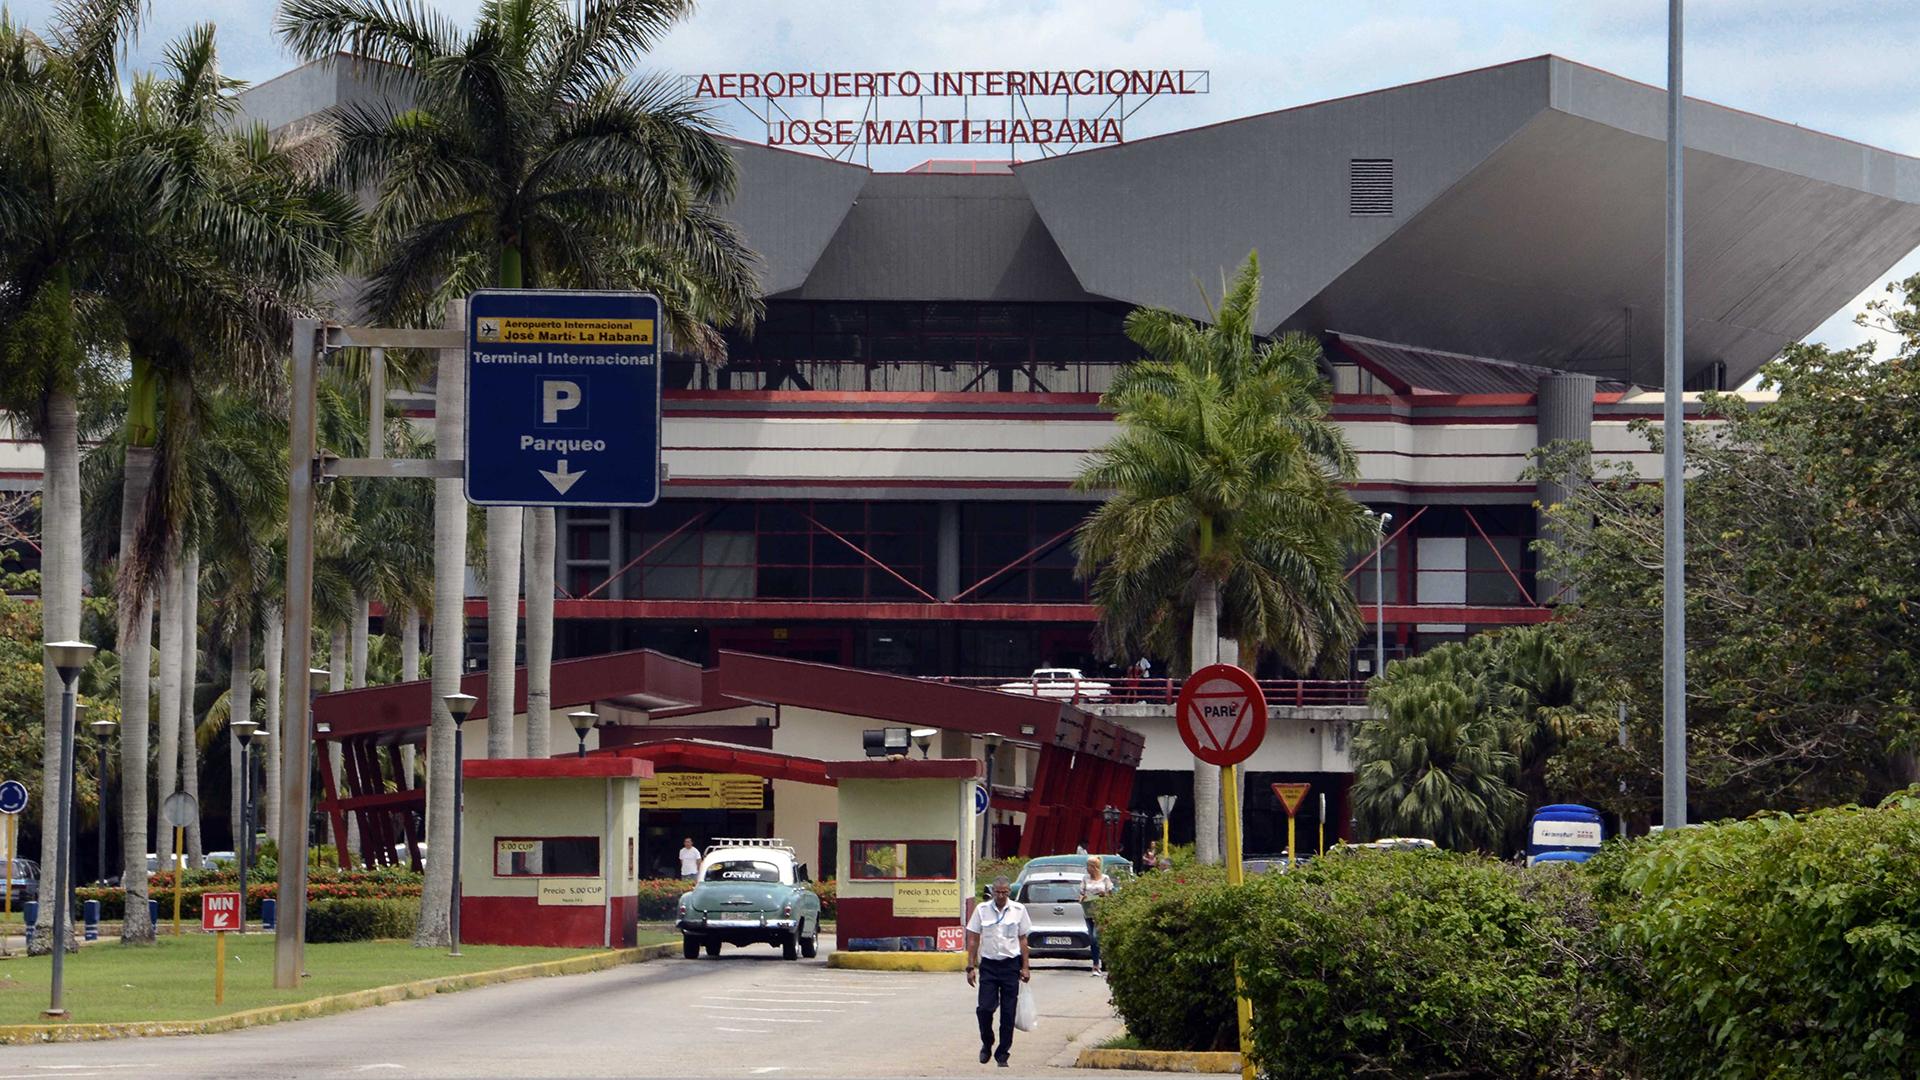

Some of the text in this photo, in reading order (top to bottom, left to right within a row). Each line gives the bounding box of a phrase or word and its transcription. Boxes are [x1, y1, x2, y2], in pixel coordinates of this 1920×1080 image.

[695, 69, 1196, 98] AEROPUERTO INTERNACIONAL
[769, 120, 853, 145] JOSE
[504, 320, 633, 330] Aeropuerto Internacional
[579, 332, 595, 342] La
[599, 332, 649, 342] Habana
[473, 351, 655, 365] Terminal Internacional
[543, 380, 582, 423] P
[520, 435, 606, 455] Parqueo
[518, 843, 534, 851] CUP
[543, 887, 566, 895] Precio
[587, 886, 603, 894] CUP
[898, 888, 922, 896] Precio
[942, 888, 959, 896] CUC
[208, 897, 234, 911] MN
[939, 929, 963, 938] CUC
